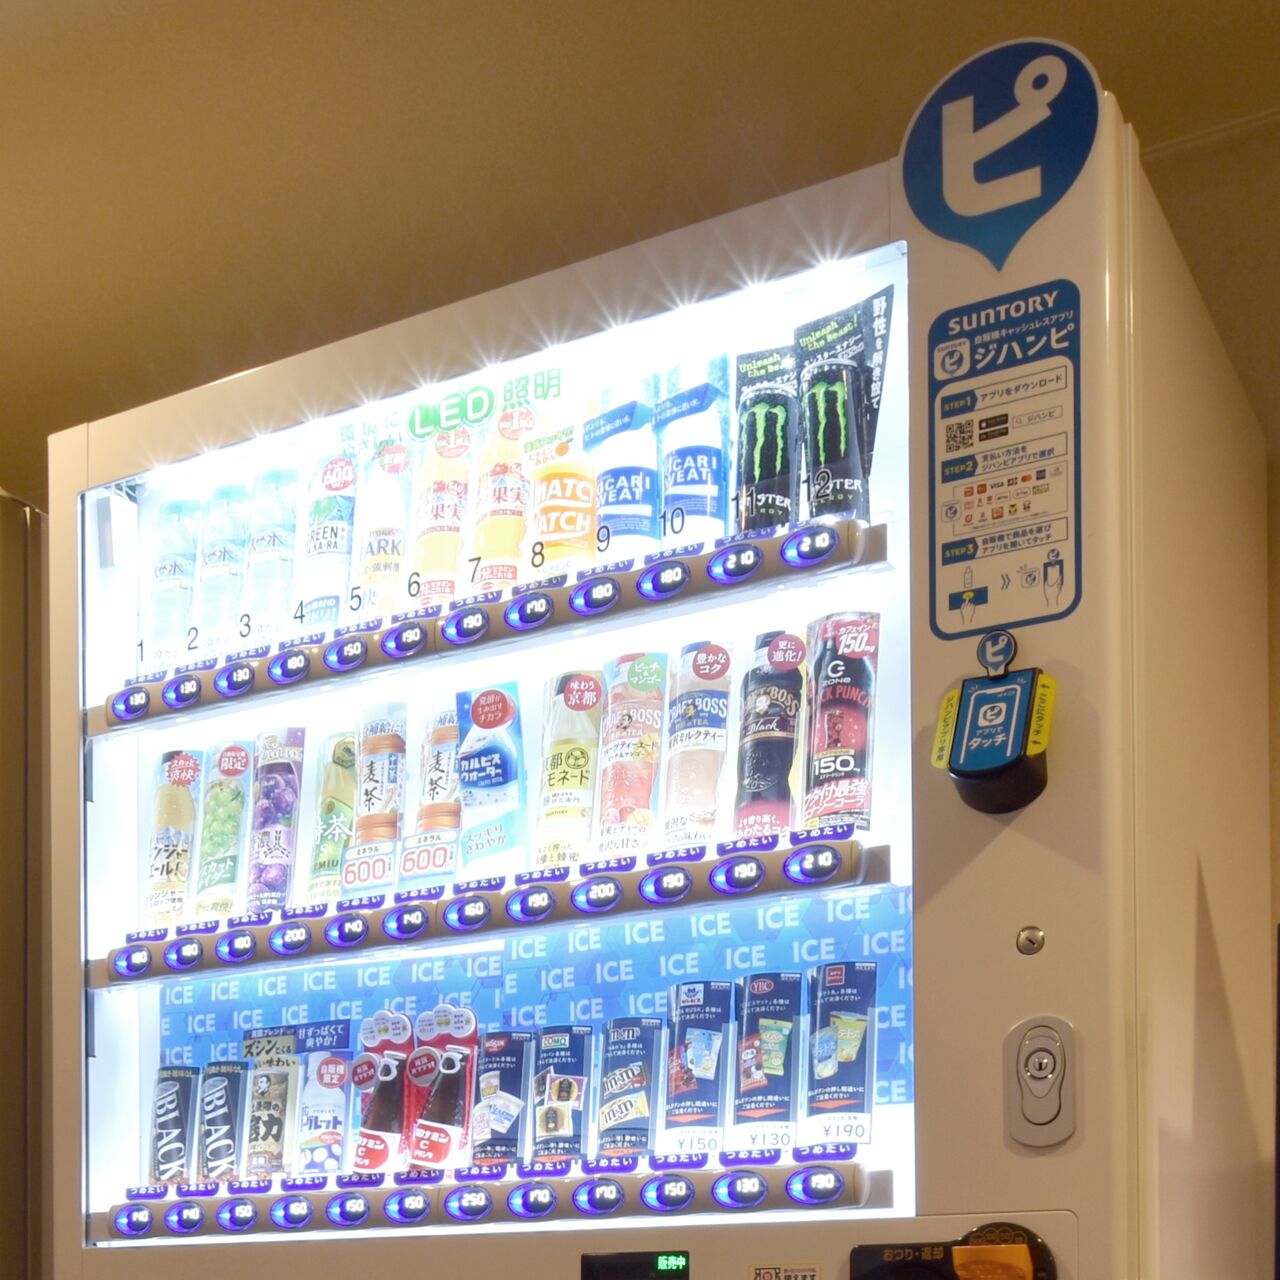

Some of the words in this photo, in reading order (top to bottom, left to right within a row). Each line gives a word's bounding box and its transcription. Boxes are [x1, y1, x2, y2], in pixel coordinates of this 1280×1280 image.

[941, 54, 1068, 217] ピ
[948, 290, 1058, 335] SUNTORY
[800, 321, 838, 347] Unleash
[808, 339, 824, 351] the
[827, 314, 859, 344] Beast!
[975, 323, 1074, 369] ジハンピ
[739, 353, 781, 373] Unleash
[981, 375, 1062, 401] アプリをダウンロード
[413, 389, 490, 435] LED
[503, 367, 561, 410] 照明
[664, 456, 718, 476] OCARI
[664, 469, 708, 489] WEAT
[802, 470, 832, 502] 12
[492, 488, 527, 503] 果実
[659, 508, 685, 537] 10
[801, 532, 829, 550] 210
[531, 542, 545, 567] 8
[651, 544, 700, 558] つめたい
[469, 557, 482, 583] 7
[350, 587, 361, 610] 5
[593, 585, 612, 599] 180
[240, 614, 251, 637] 3
[839, 624, 870, 636] カフェイン
[284, 635, 321, 647] つめたい
[402, 629, 420, 642] 190
[137, 640, 144, 661] 1
[778, 640, 796, 650] 更に
[986, 636, 1007, 662] ピ
[696, 653, 727, 665] 豊かな
[771, 649, 803, 663] 進化!
[633, 662, 660, 673] ピーチ
[700, 664, 722, 674] コク
[180, 681, 196, 694] 130
[570, 681, 594, 691] 味わう
[630, 675, 662, 685] マンゴー
[567, 692, 597, 706] 京都
[696, 697, 727, 715] BOSS
[770, 686, 800, 717] BOSS
[479, 712, 502, 723] チカラ
[630, 711, 662, 728] BOSS
[748, 718, 780, 734] Black
[969, 734, 1007, 749] タッチ
[221, 758, 246, 771] 限定
[460, 753, 501, 772] カルピス
[813, 756, 854, 776] 150
[428, 751, 448, 801] 麦茶
[460, 767, 502, 782] ウォーター
[416, 835, 442, 844] ミネラル
[465, 824, 503, 845] スッキリ
[466, 835, 507, 855] さわやか
[402, 846, 448, 872] 600
[587, 858, 630, 871] つめたい
[344, 858, 385, 885] 600
[663, 874, 684, 888] 190
[528, 893, 548, 907] 190
[625, 921, 664, 944] ICE
[863, 930, 905, 955] ICE
[753, 981, 771, 992] YBC
[165, 986, 193, 1005] ICE
[630, 992, 667, 1015] ICE
[298, 1024, 345, 1040] 甘ずっぱくて
[244, 1040, 293, 1058] ズシンとくる
[305, 1035, 337, 1049] 爽やか!
[544, 1036, 568, 1048] COMO
[211, 1042, 237, 1061] ICE
[323, 1074, 340, 1084] 限定
[202, 1091, 236, 1180] BLACK
[823, 1124, 865, 1138] ¥190
[420, 1141, 428, 1150] C
[678, 1137, 718, 1151] ¥150
[749, 1132, 791, 1147] ¥130
[800, 1144, 850, 1154] つめたい
[812, 1174, 834, 1188] 190
[132, 1185, 164, 1194] つめたい
[596, 1186, 616, 1199] 170
[462, 1190, 486, 1206] 250
[236, 1206, 252, 1217] 150
[658, 1256, 686, 1270] 販売中
